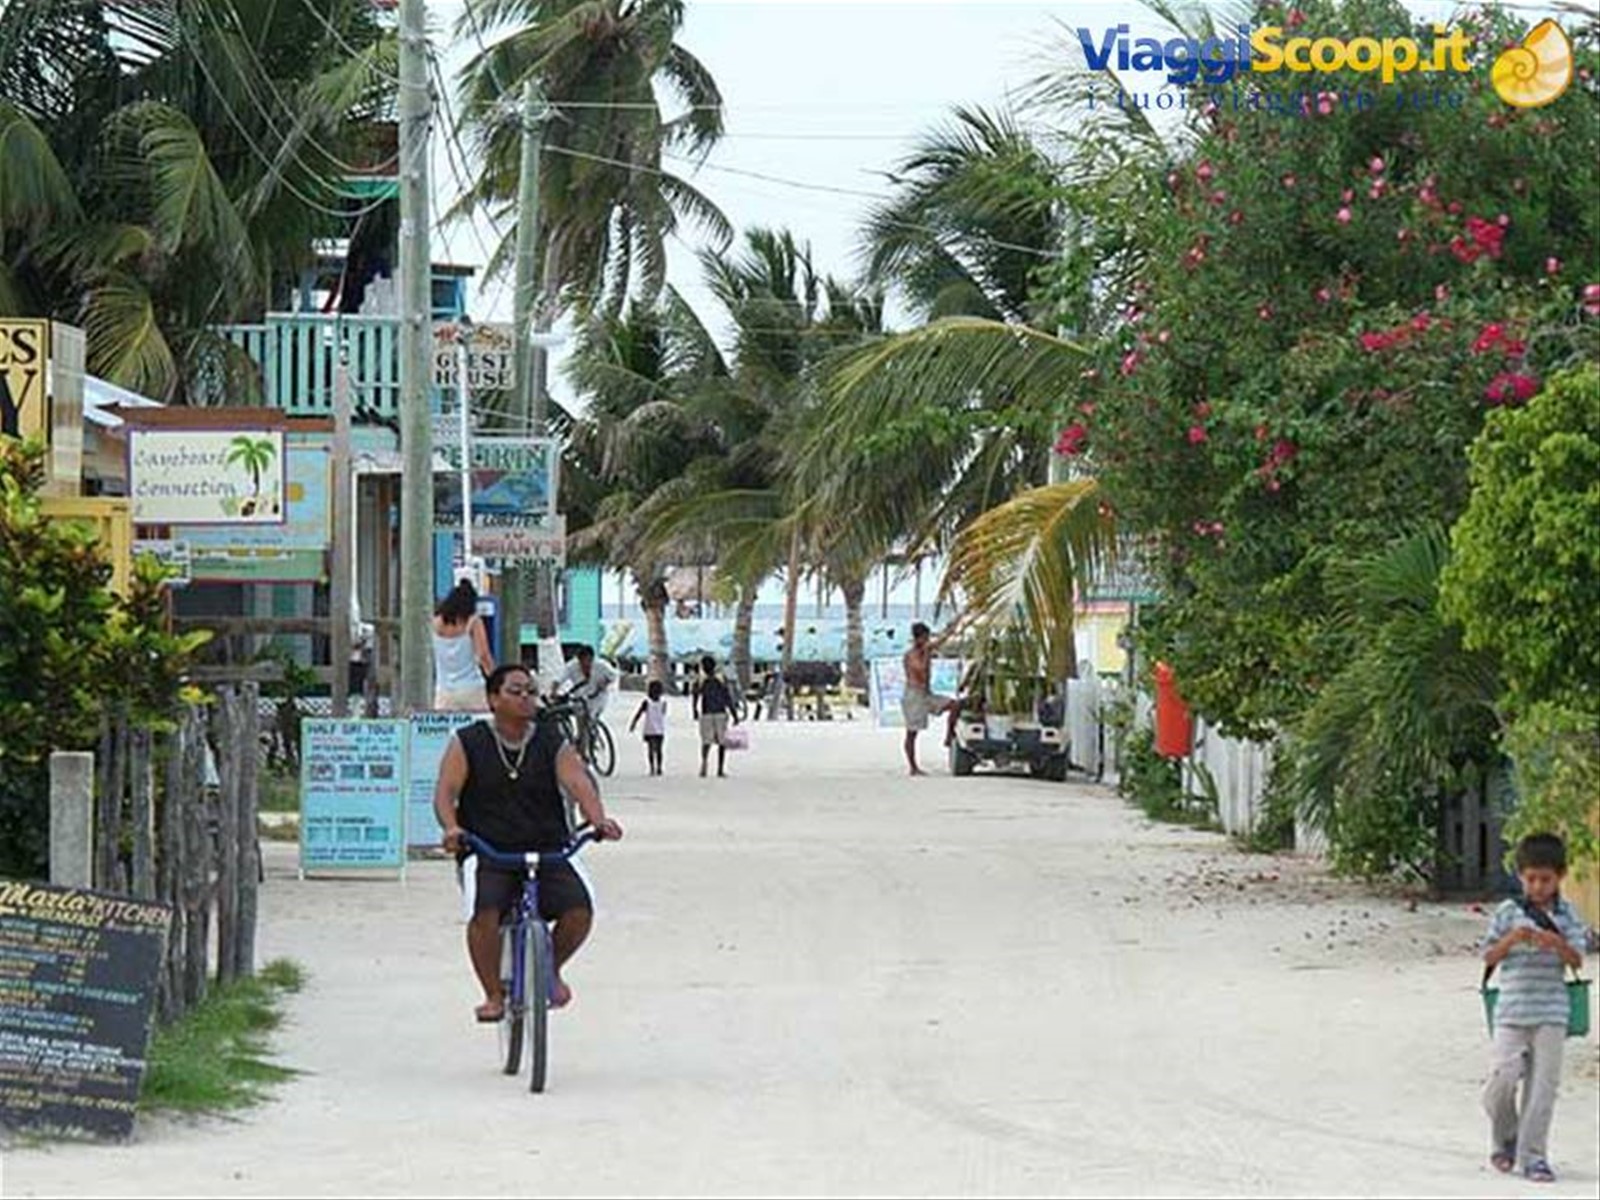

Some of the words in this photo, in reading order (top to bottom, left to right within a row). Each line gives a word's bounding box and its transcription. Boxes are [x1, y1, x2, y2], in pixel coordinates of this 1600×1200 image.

[0, 327, 38, 364] S
[136, 477, 236, 497] Connection
[91, 897, 173, 927] KITCHEN
